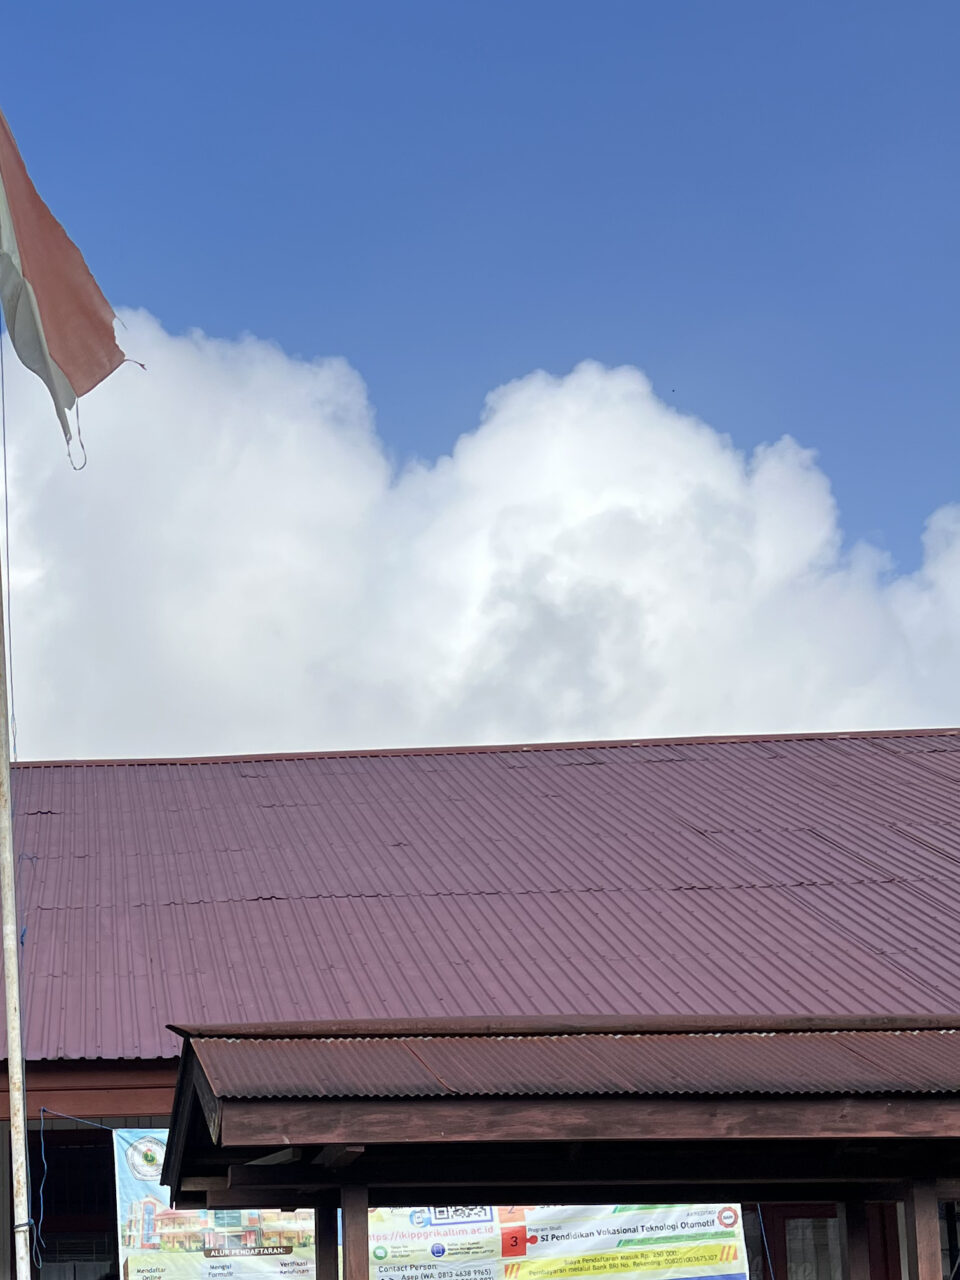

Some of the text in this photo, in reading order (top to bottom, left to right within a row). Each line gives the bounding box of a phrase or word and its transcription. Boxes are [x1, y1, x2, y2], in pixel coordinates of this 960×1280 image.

[551, 1231, 594, 1242] Pendidikan
[596, 1225, 639, 1236] Vokasional
[640, 1222, 679, 1233] Teknologi
[680, 1219, 715, 1230] Otomotif
[510, 1235, 518, 1247] 3
[378, 1265, 408, 1273] Contact
[401, 1273, 419, 1280] Asep
[437, 1271, 453, 1279] 0813
